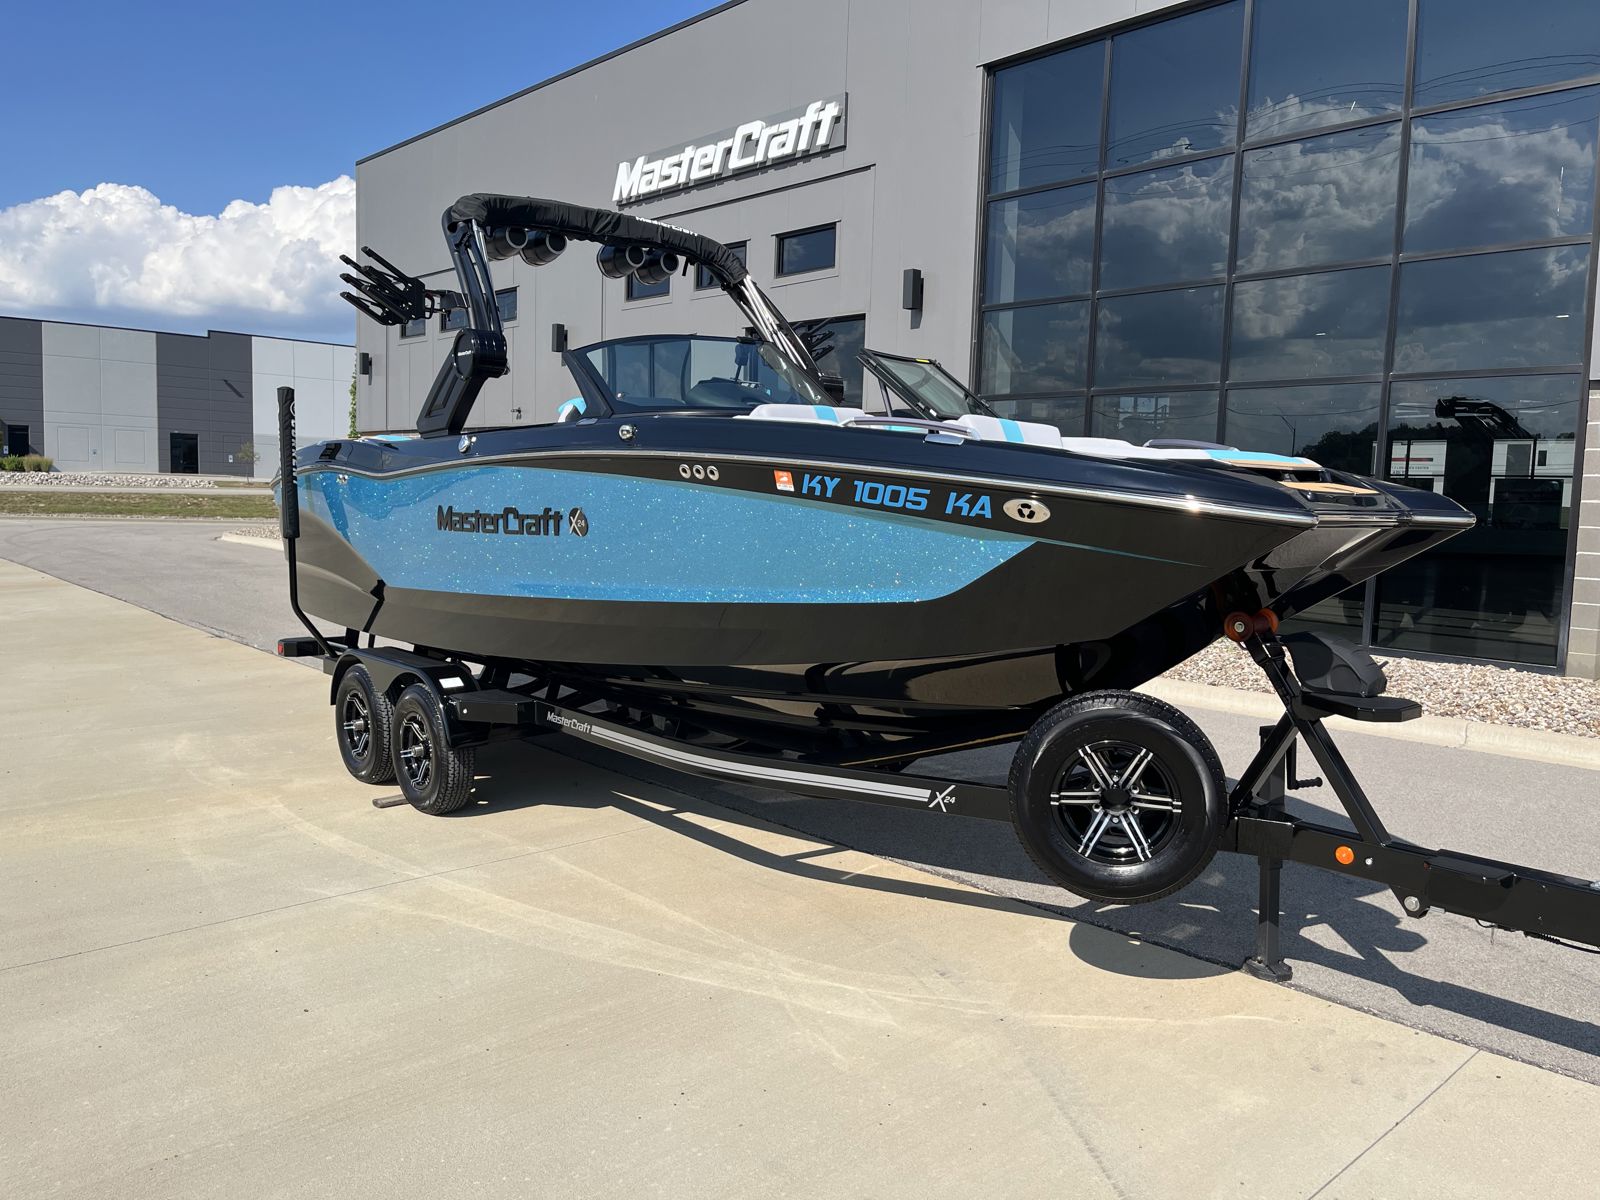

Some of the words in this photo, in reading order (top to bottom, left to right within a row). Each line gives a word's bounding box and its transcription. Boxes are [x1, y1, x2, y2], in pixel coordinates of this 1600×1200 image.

[612, 100, 843, 202] MasterCraft
[801, 473, 840, 497] KY
[853, 480, 930, 511] 1005
[945, 492, 993, 519] KA
[437, 504, 563, 536] MasterCraft
[546, 711, 590, 733] MasterCraft
